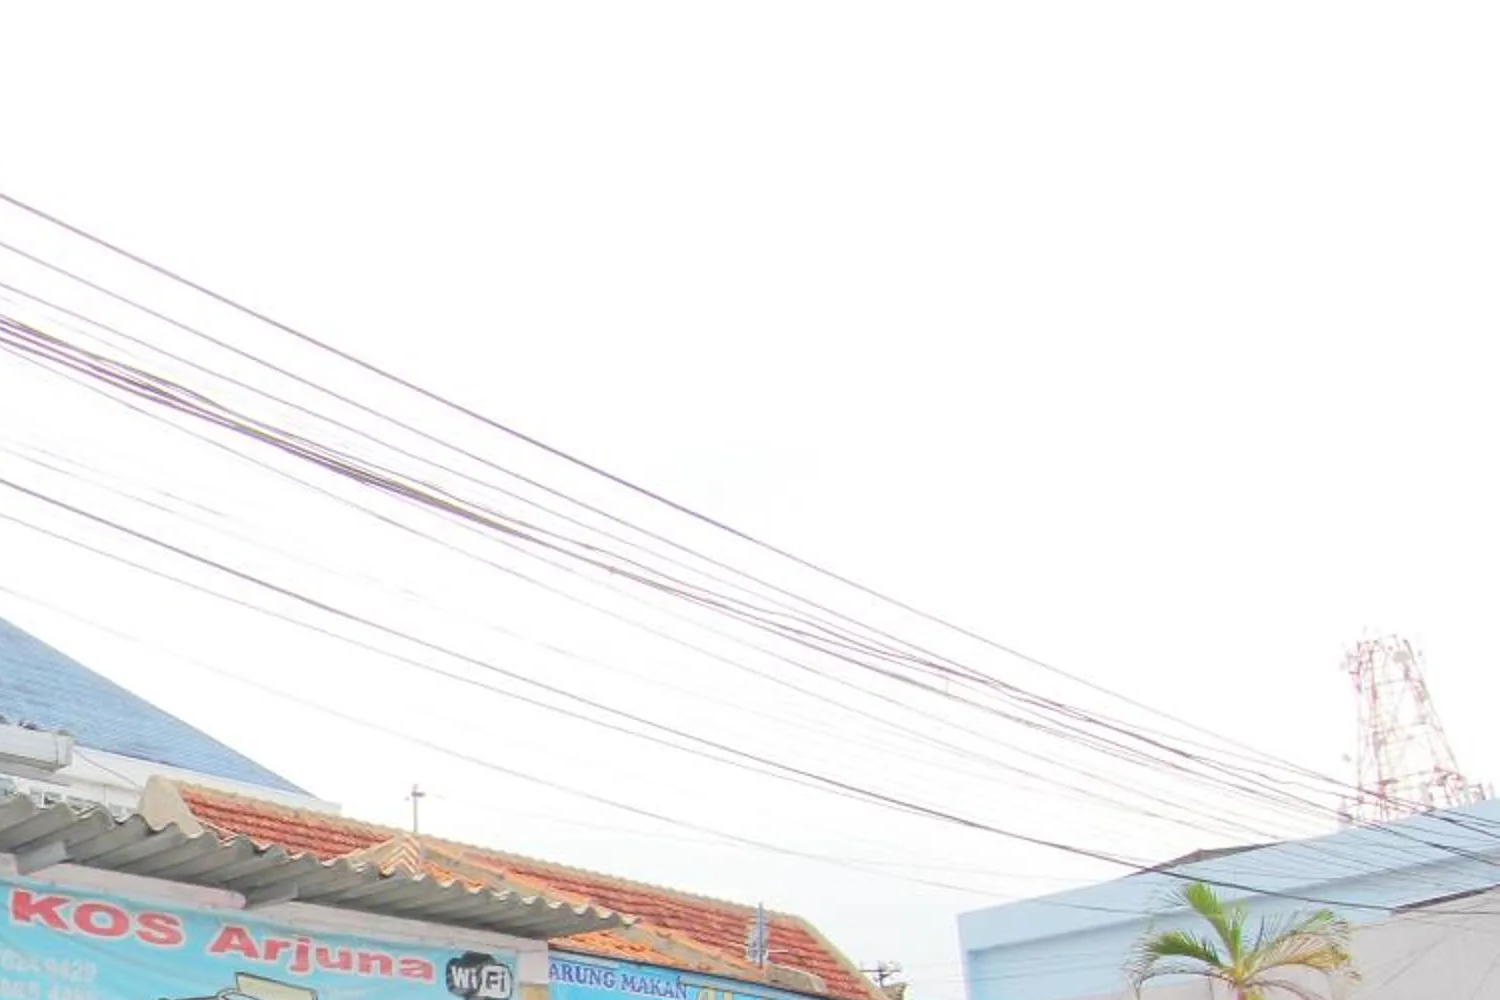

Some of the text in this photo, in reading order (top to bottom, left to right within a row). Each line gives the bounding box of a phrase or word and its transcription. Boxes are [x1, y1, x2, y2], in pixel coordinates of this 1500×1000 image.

[10, 888, 436, 981] KOS Arjuna
[451, 964, 512, 1000] WiFi
[549, 962, 688, 1000] ARUNG MAKAN
